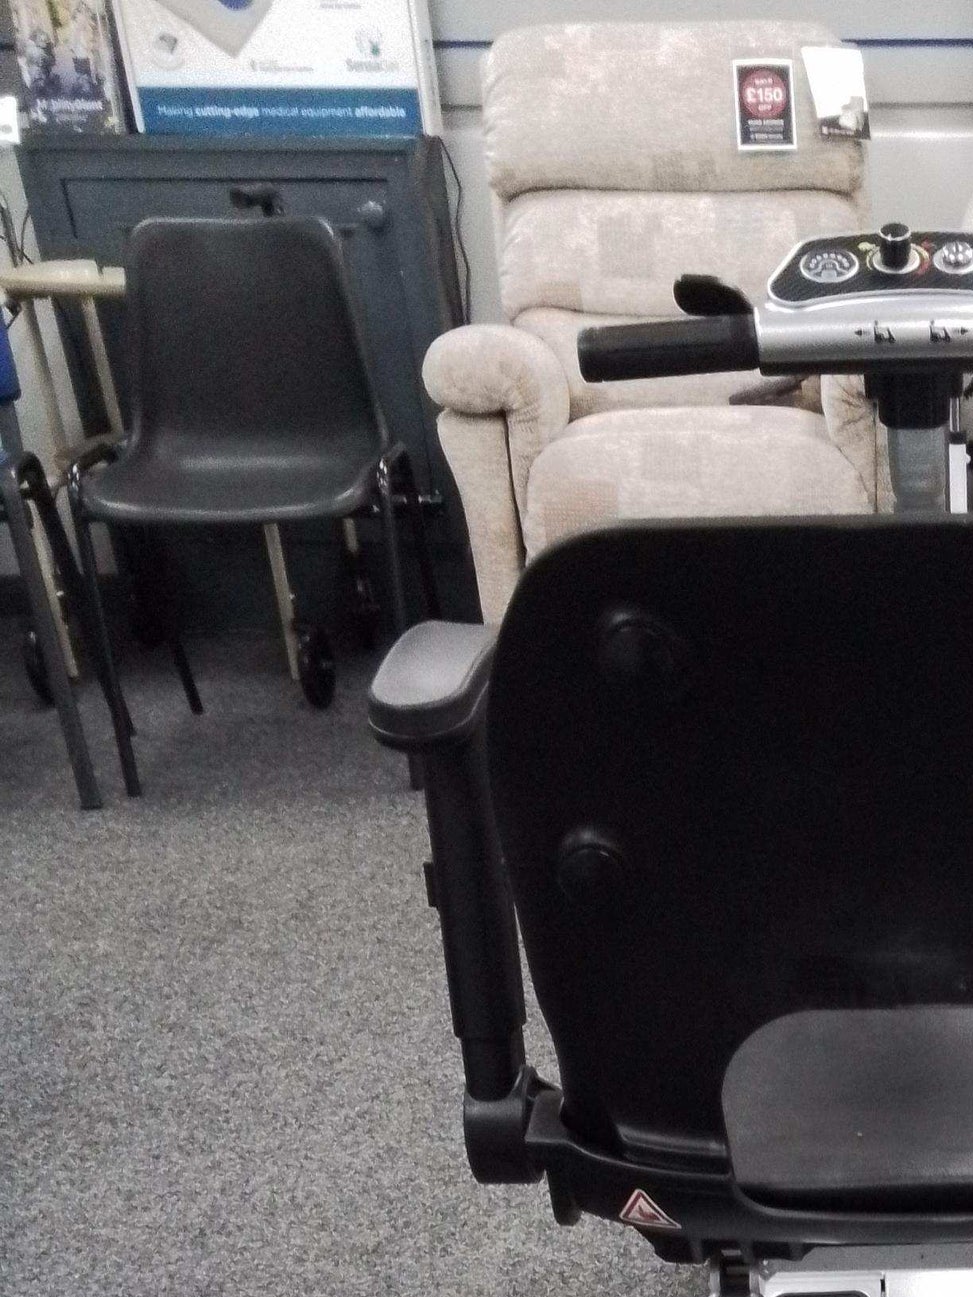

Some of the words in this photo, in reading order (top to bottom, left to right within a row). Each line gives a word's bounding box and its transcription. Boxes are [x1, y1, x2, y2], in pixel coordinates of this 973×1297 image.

[746, 86, 783, 103] £150
[195, 105, 260, 119] cutting-edge
[262, 106, 299, 118] medical
[301, 106, 353, 119] equipment
[355, 105, 406, 118] affordable
